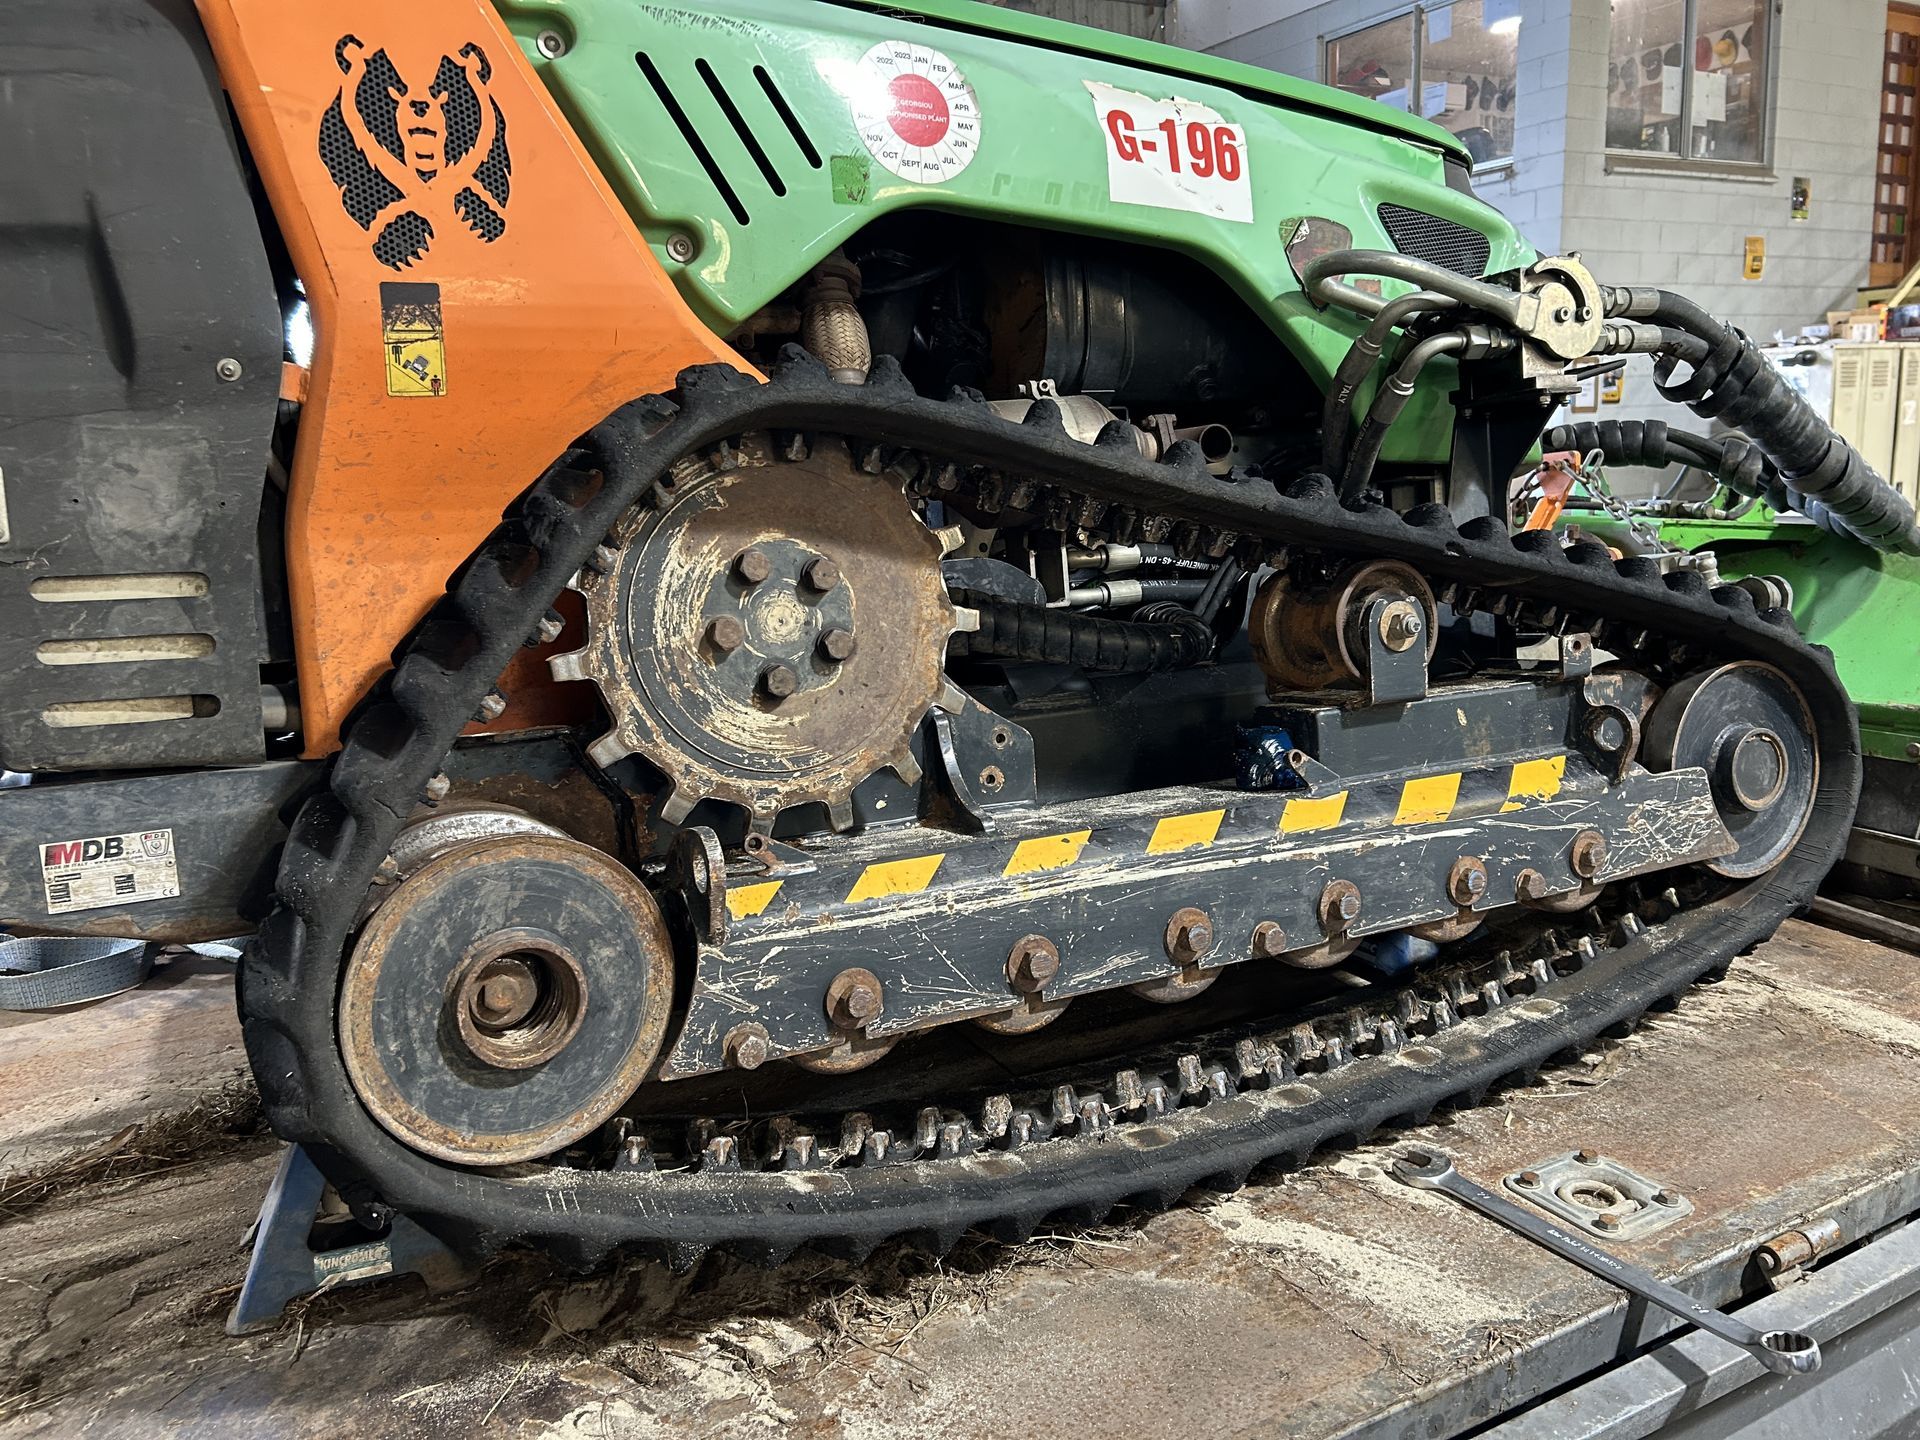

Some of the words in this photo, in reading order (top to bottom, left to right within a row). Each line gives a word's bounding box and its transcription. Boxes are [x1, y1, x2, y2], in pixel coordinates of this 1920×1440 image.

[894, 51, 911, 60] 2023
[913, 56, 928, 64] JAN
[876, 56, 894, 65] 2022
[932, 64, 947, 73] FEB
[947, 82, 965, 91] MAR
[954, 103, 969, 112] APR
[928, 113, 948, 124] PLANT
[957, 122, 974, 131] MAY
[866, 133, 883, 142] NOV
[952, 140, 968, 148] JUN
[1106, 109, 1241, 182] G-196
[882, 151, 899, 159] OCT
[902, 159, 921, 168] SEPT
[942, 156, 956, 165] JUL
[923, 162, 940, 171] AUG
[45, 836, 124, 867] MDB
